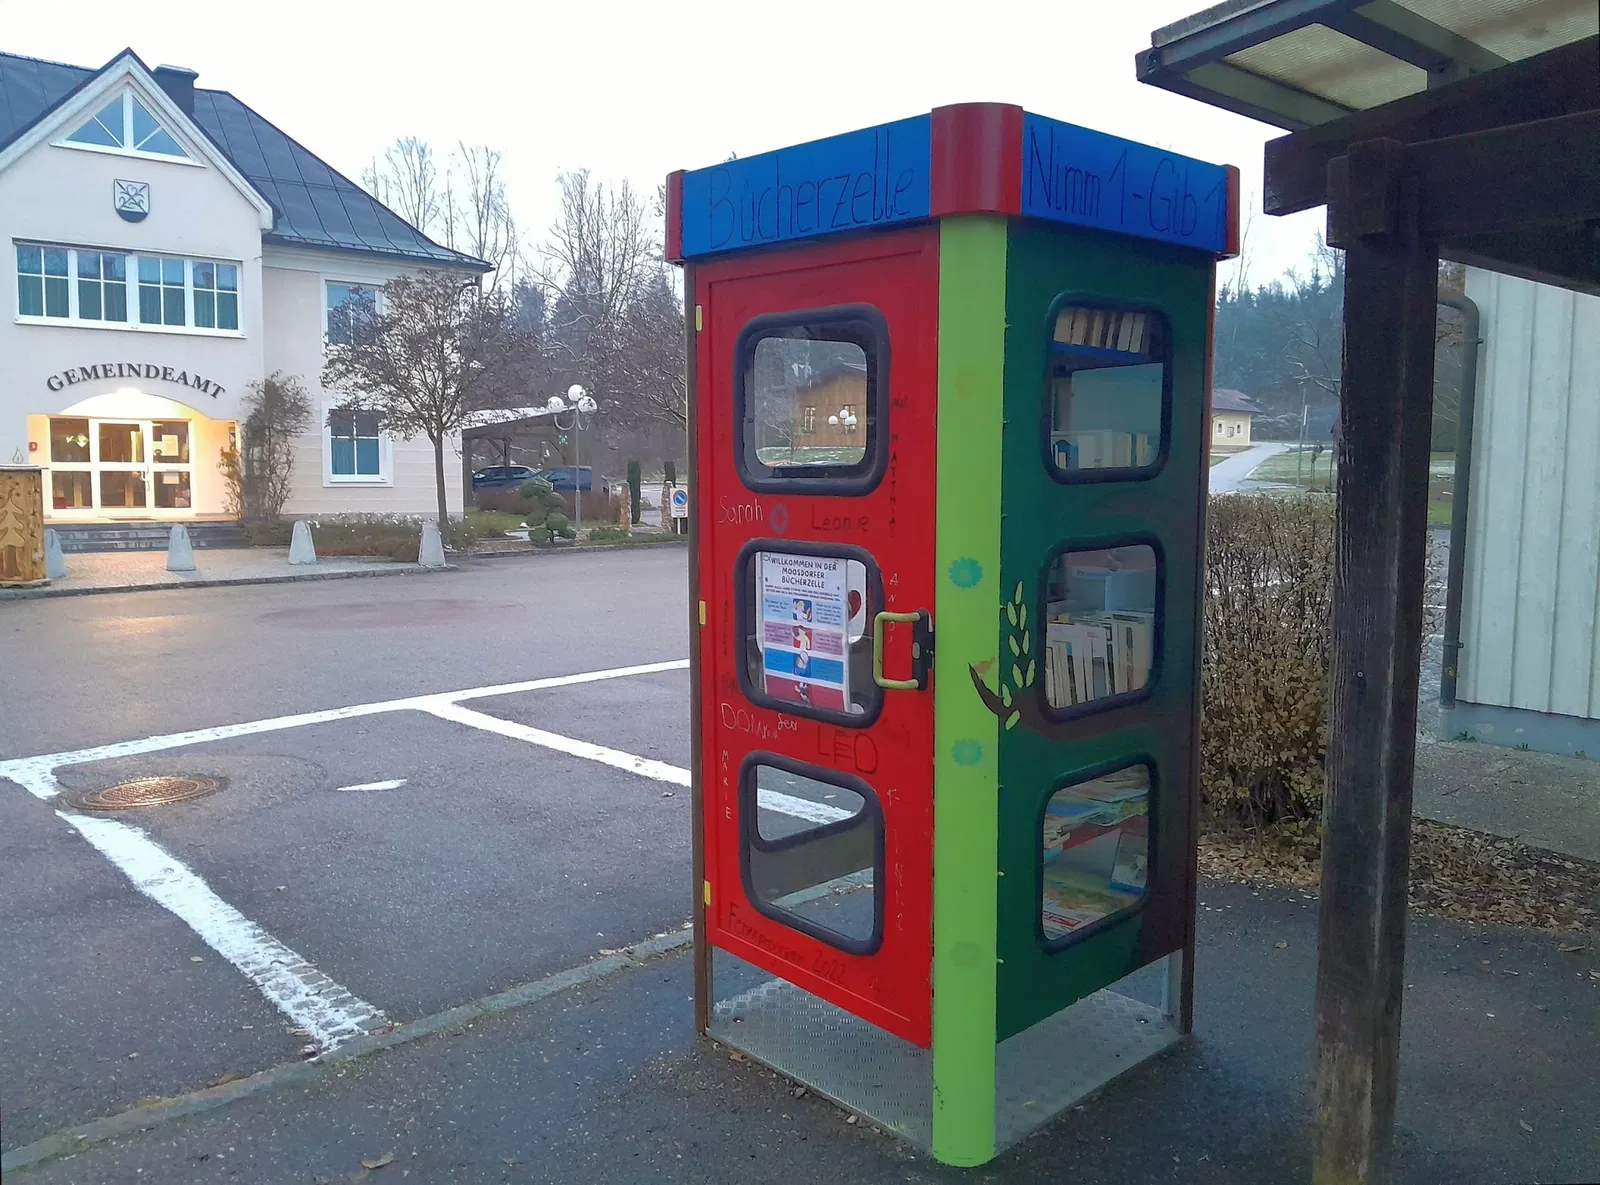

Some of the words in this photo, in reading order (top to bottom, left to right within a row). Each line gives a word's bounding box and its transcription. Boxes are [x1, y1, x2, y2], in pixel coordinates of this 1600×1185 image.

[1028, 123, 1101, 218] Nimm
[709, 128, 915, 249] Bücherzelle
[46, 362, 226, 400] GEMEINDEAMT
[718, 495, 765, 525] Sarah
[810, 504, 870, 532] Leonie
[771, 558, 813, 570] WILLKOMMEN
[814, 562, 822, 570] IN
[824, 563, 837, 571] DER
[781, 567, 825, 579] MOOSDORFER
[781, 575, 825, 589] BÜCHERZELLE
[817, 725, 879, 775] LEO
[720, 749, 732, 820] MARIE
